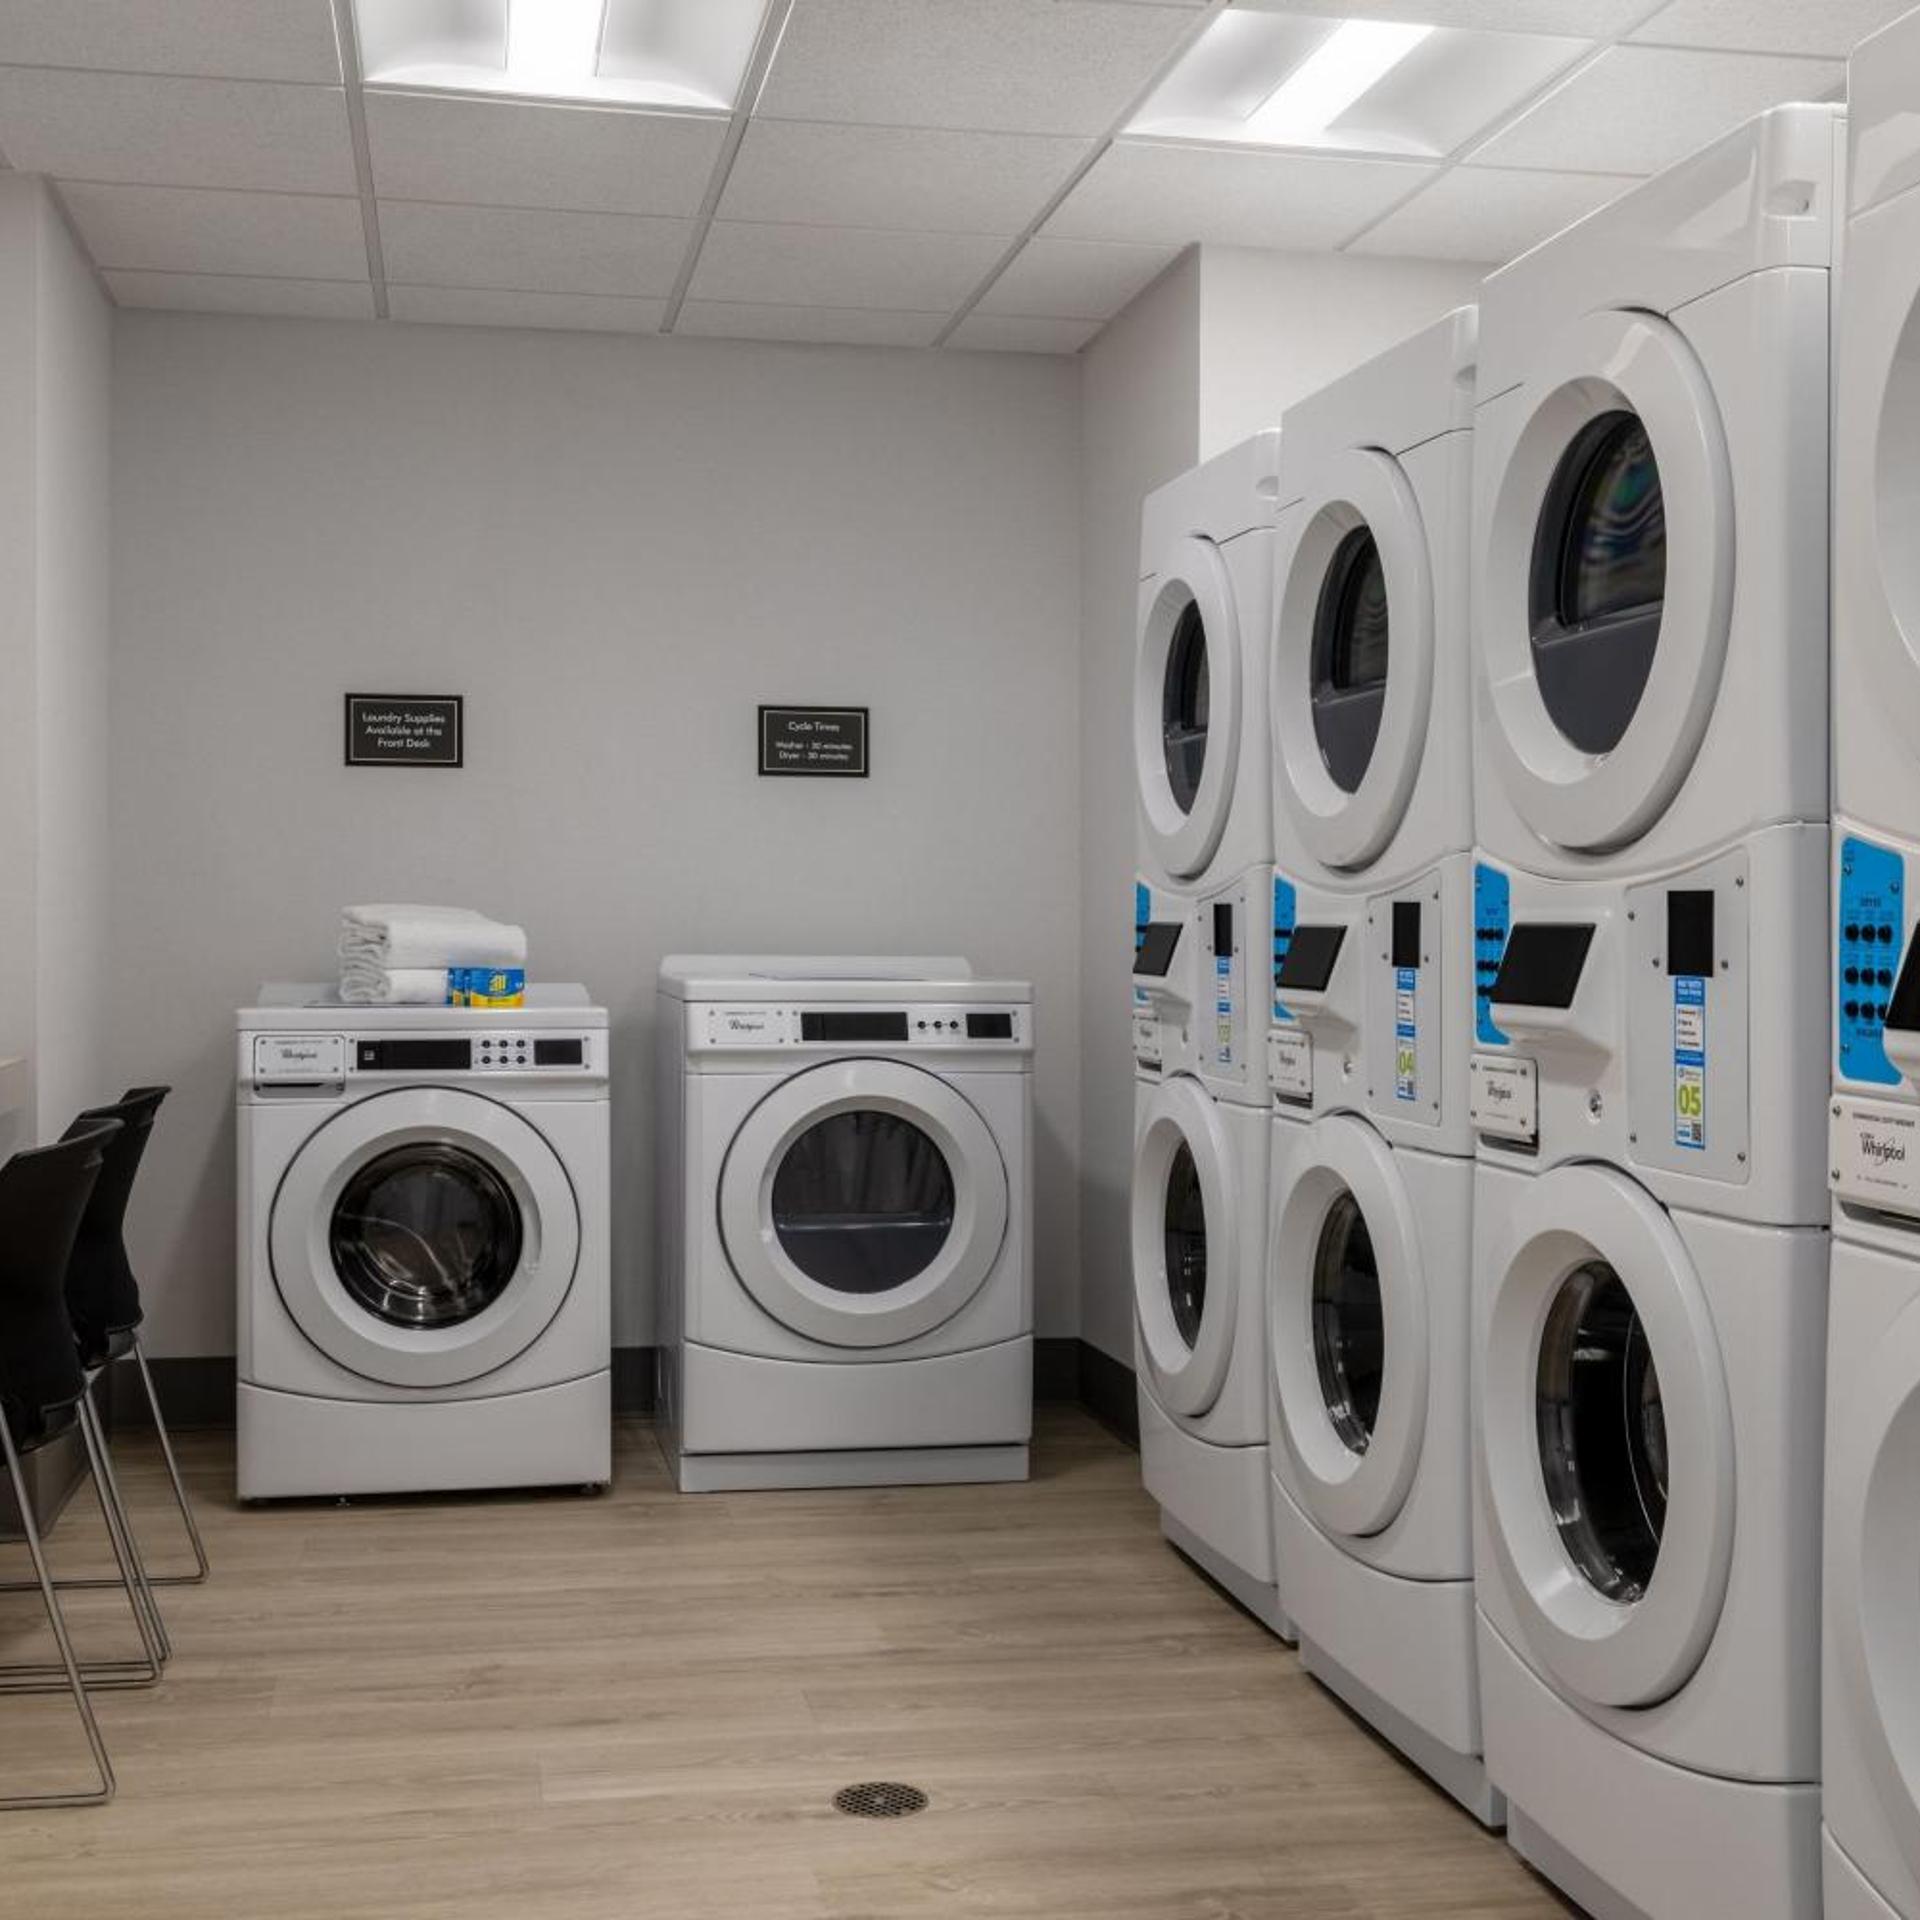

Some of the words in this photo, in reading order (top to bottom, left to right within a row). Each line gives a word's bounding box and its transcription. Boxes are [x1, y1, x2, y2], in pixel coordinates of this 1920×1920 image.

[362, 711, 401, 724] Laundry
[404, 713, 445, 724] Supplies
[365, 725, 411, 736] Available
[413, 726, 424, 736] at
[426, 726, 442, 736] the
[788, 721, 813, 732] Cycle
[377, 737, 404, 748] Front
[406, 738, 430, 748] Desk
[1679, 1085, 1702, 1116] 05
[1861, 1139, 1905, 1162] Whirlpool
